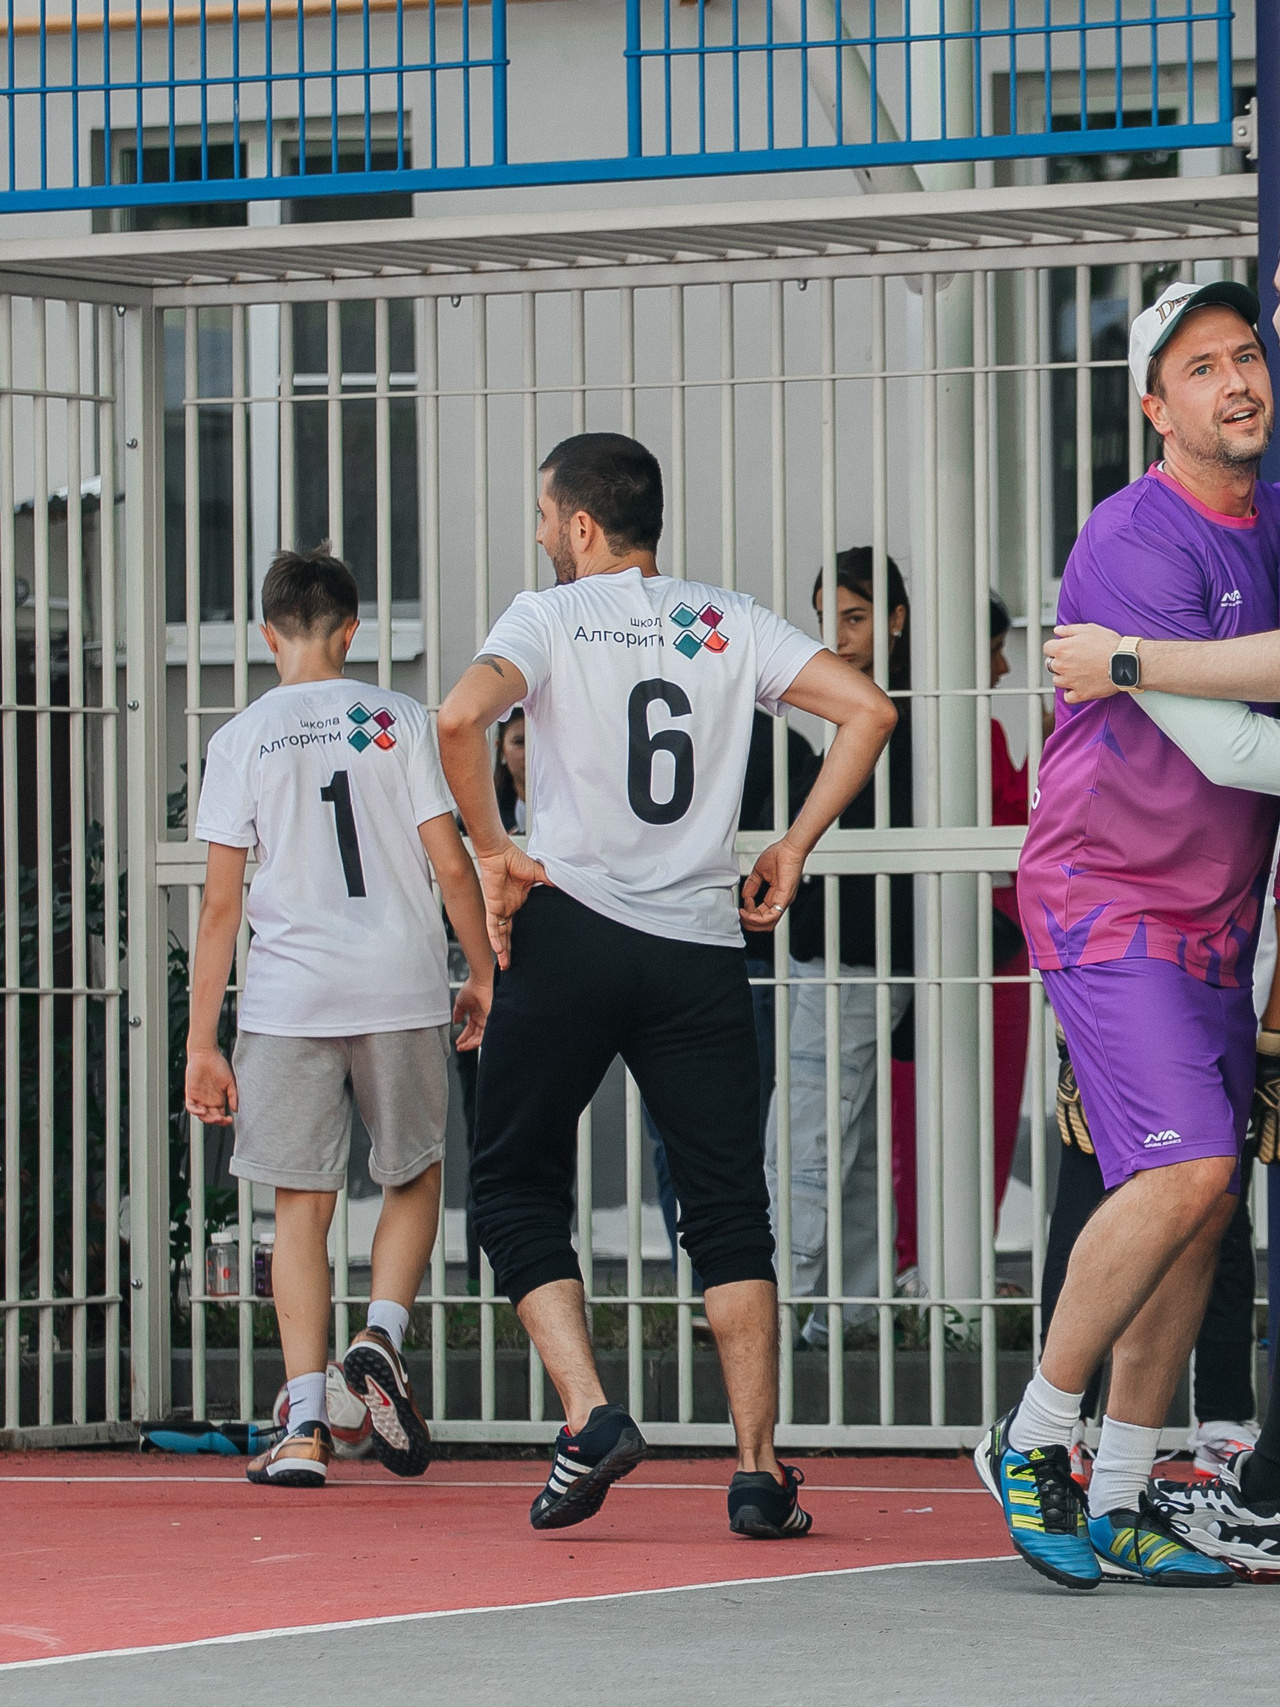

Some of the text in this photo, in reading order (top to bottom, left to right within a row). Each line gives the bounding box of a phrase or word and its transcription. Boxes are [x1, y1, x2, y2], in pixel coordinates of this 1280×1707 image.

[630, 617, 663, 628] школ
[300, 716, 341, 729] школа
[259, 731, 342, 759] Алгоритм
[628, 678, 695, 826] 6
[320, 770, 367, 898] 1
